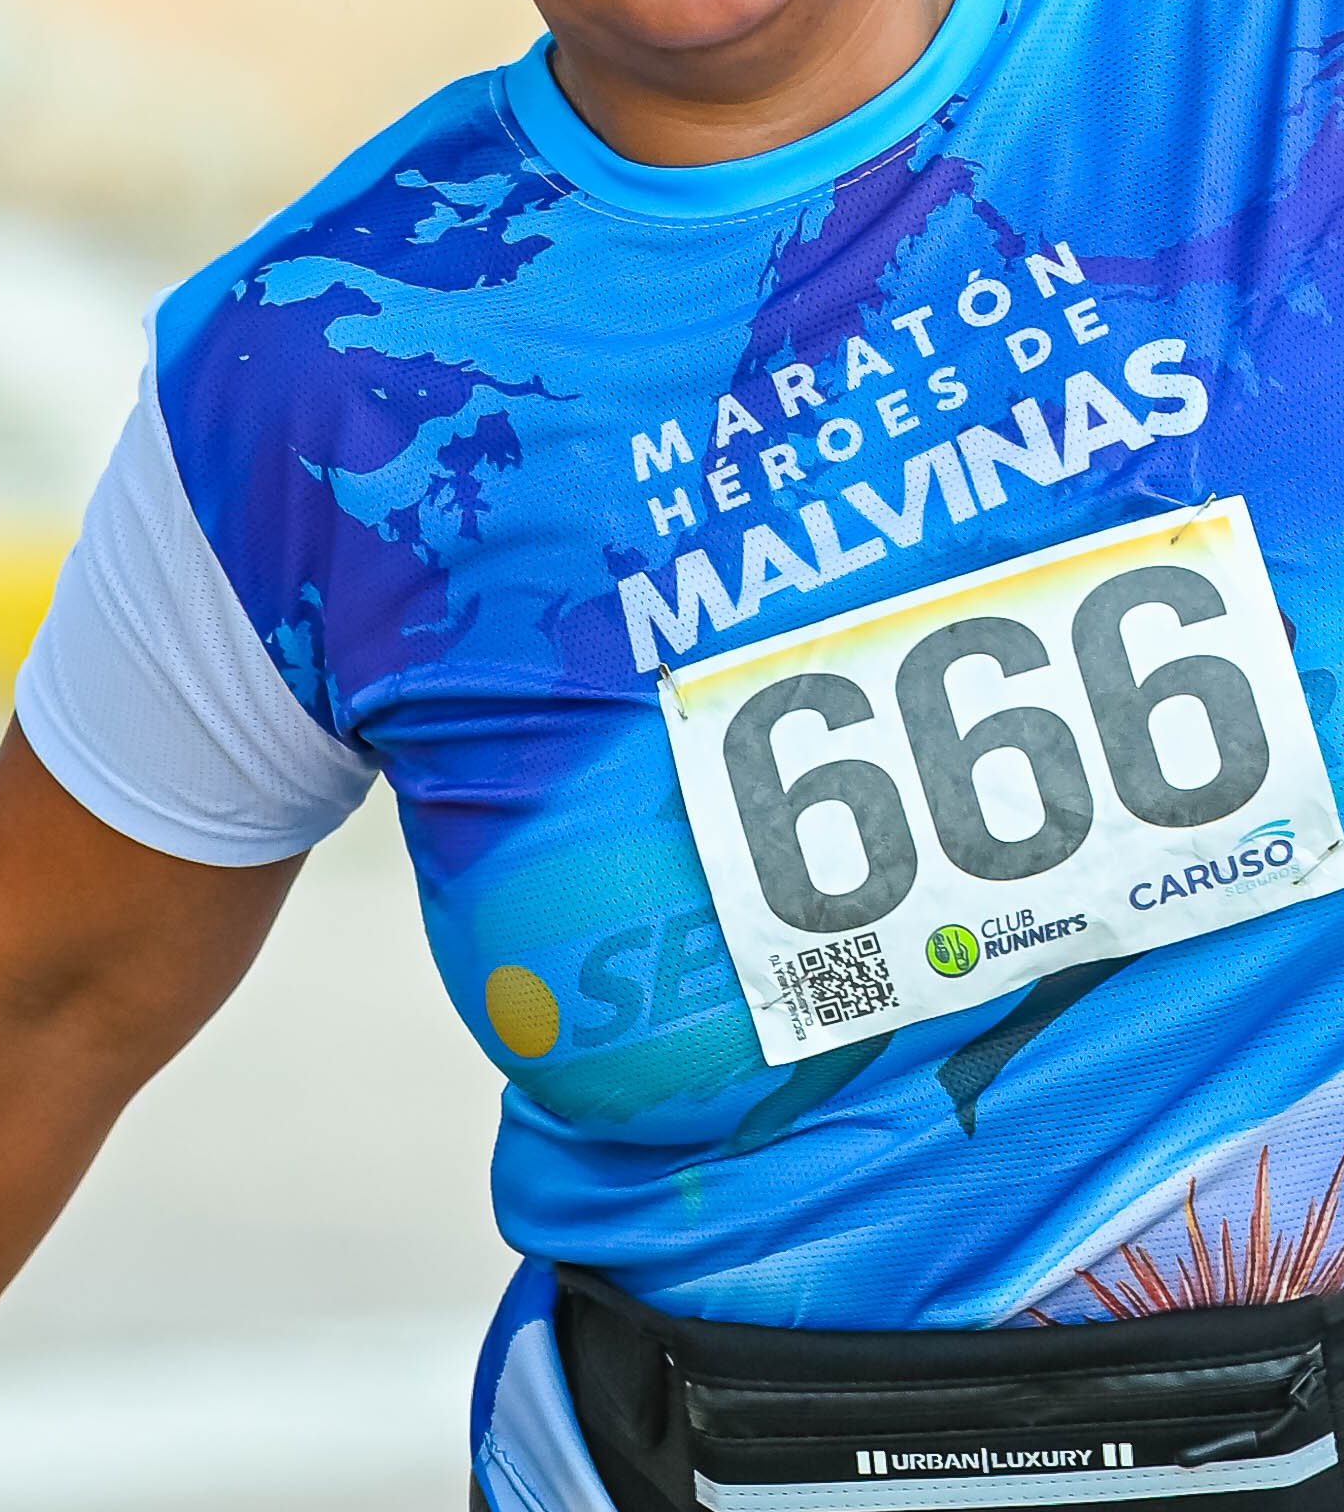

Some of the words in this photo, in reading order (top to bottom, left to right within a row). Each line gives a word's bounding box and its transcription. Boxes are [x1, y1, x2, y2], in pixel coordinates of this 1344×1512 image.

[631, 241, 1086, 481] MARATÓN
[648, 365, 968, 536] HÉROES
[1006, 298, 1109, 373] DE
[617, 338, 1209, 673] MALVINAS
[722, 565, 1270, 934] 666
[981, 909, 1034, 939] CLUB
[984, 913, 1088, 960] RUNNER'S
[1129, 840, 1294, 911] CARUSO
[1225, 863, 1302, 898] SEGUROS
[573, 906, 744, 1048] SE
